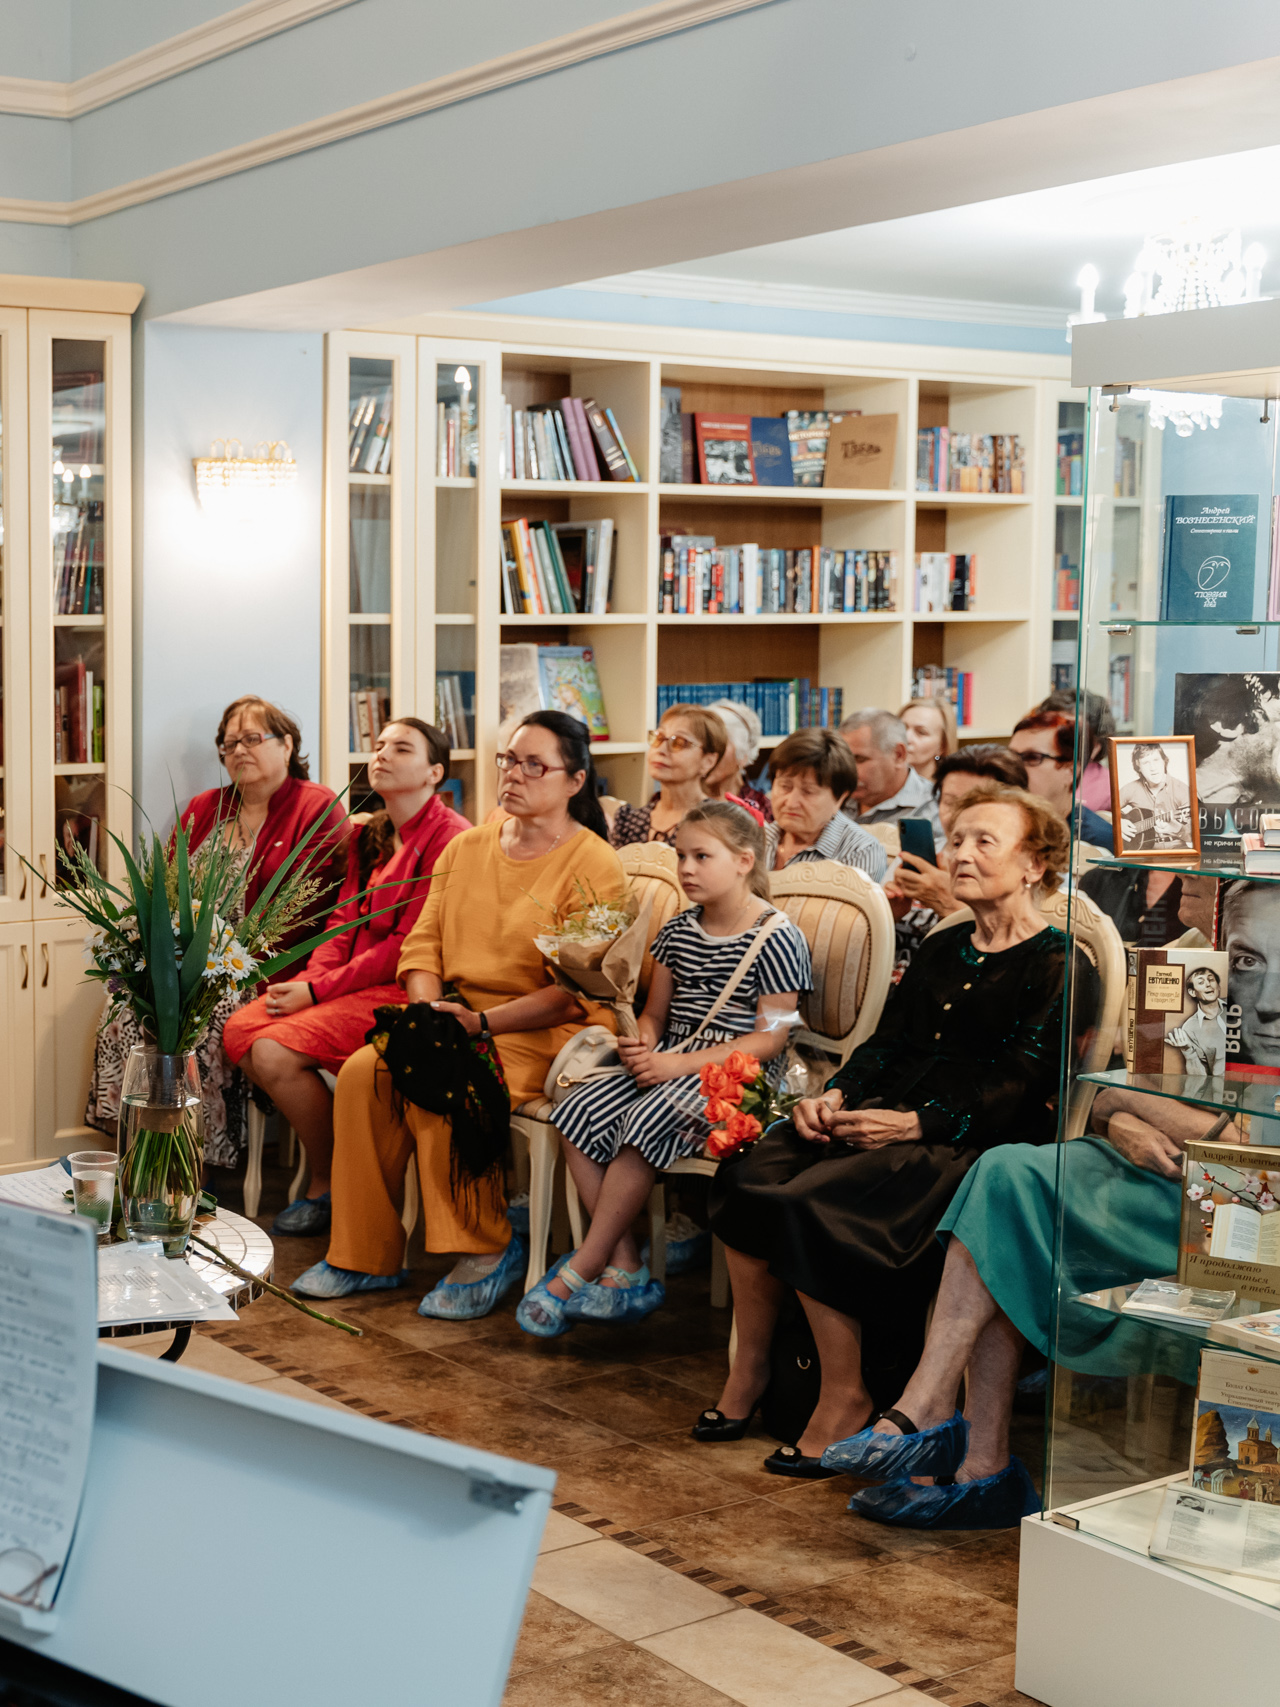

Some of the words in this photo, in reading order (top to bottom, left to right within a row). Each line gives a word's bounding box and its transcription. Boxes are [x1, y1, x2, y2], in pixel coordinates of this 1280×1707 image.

[1201, 507, 1231, 516] Андрей
[1175, 514, 1256, 525] ВОЗНЕСЕНСКИЙ
[1199, 807, 1275, 831] ВЫСО
[1148, 977, 1180, 985] ЕВТУШЕНКО
[1225, 1004, 1243, 1054] ВЕСЬ
[1201, 1150, 1234, 1161] Андрей
[1189, 1255, 1198, 1264] Я
[1200, 1259, 1262, 1274] продолжаю
[1204, 1269, 1269, 1284] влюбляться
